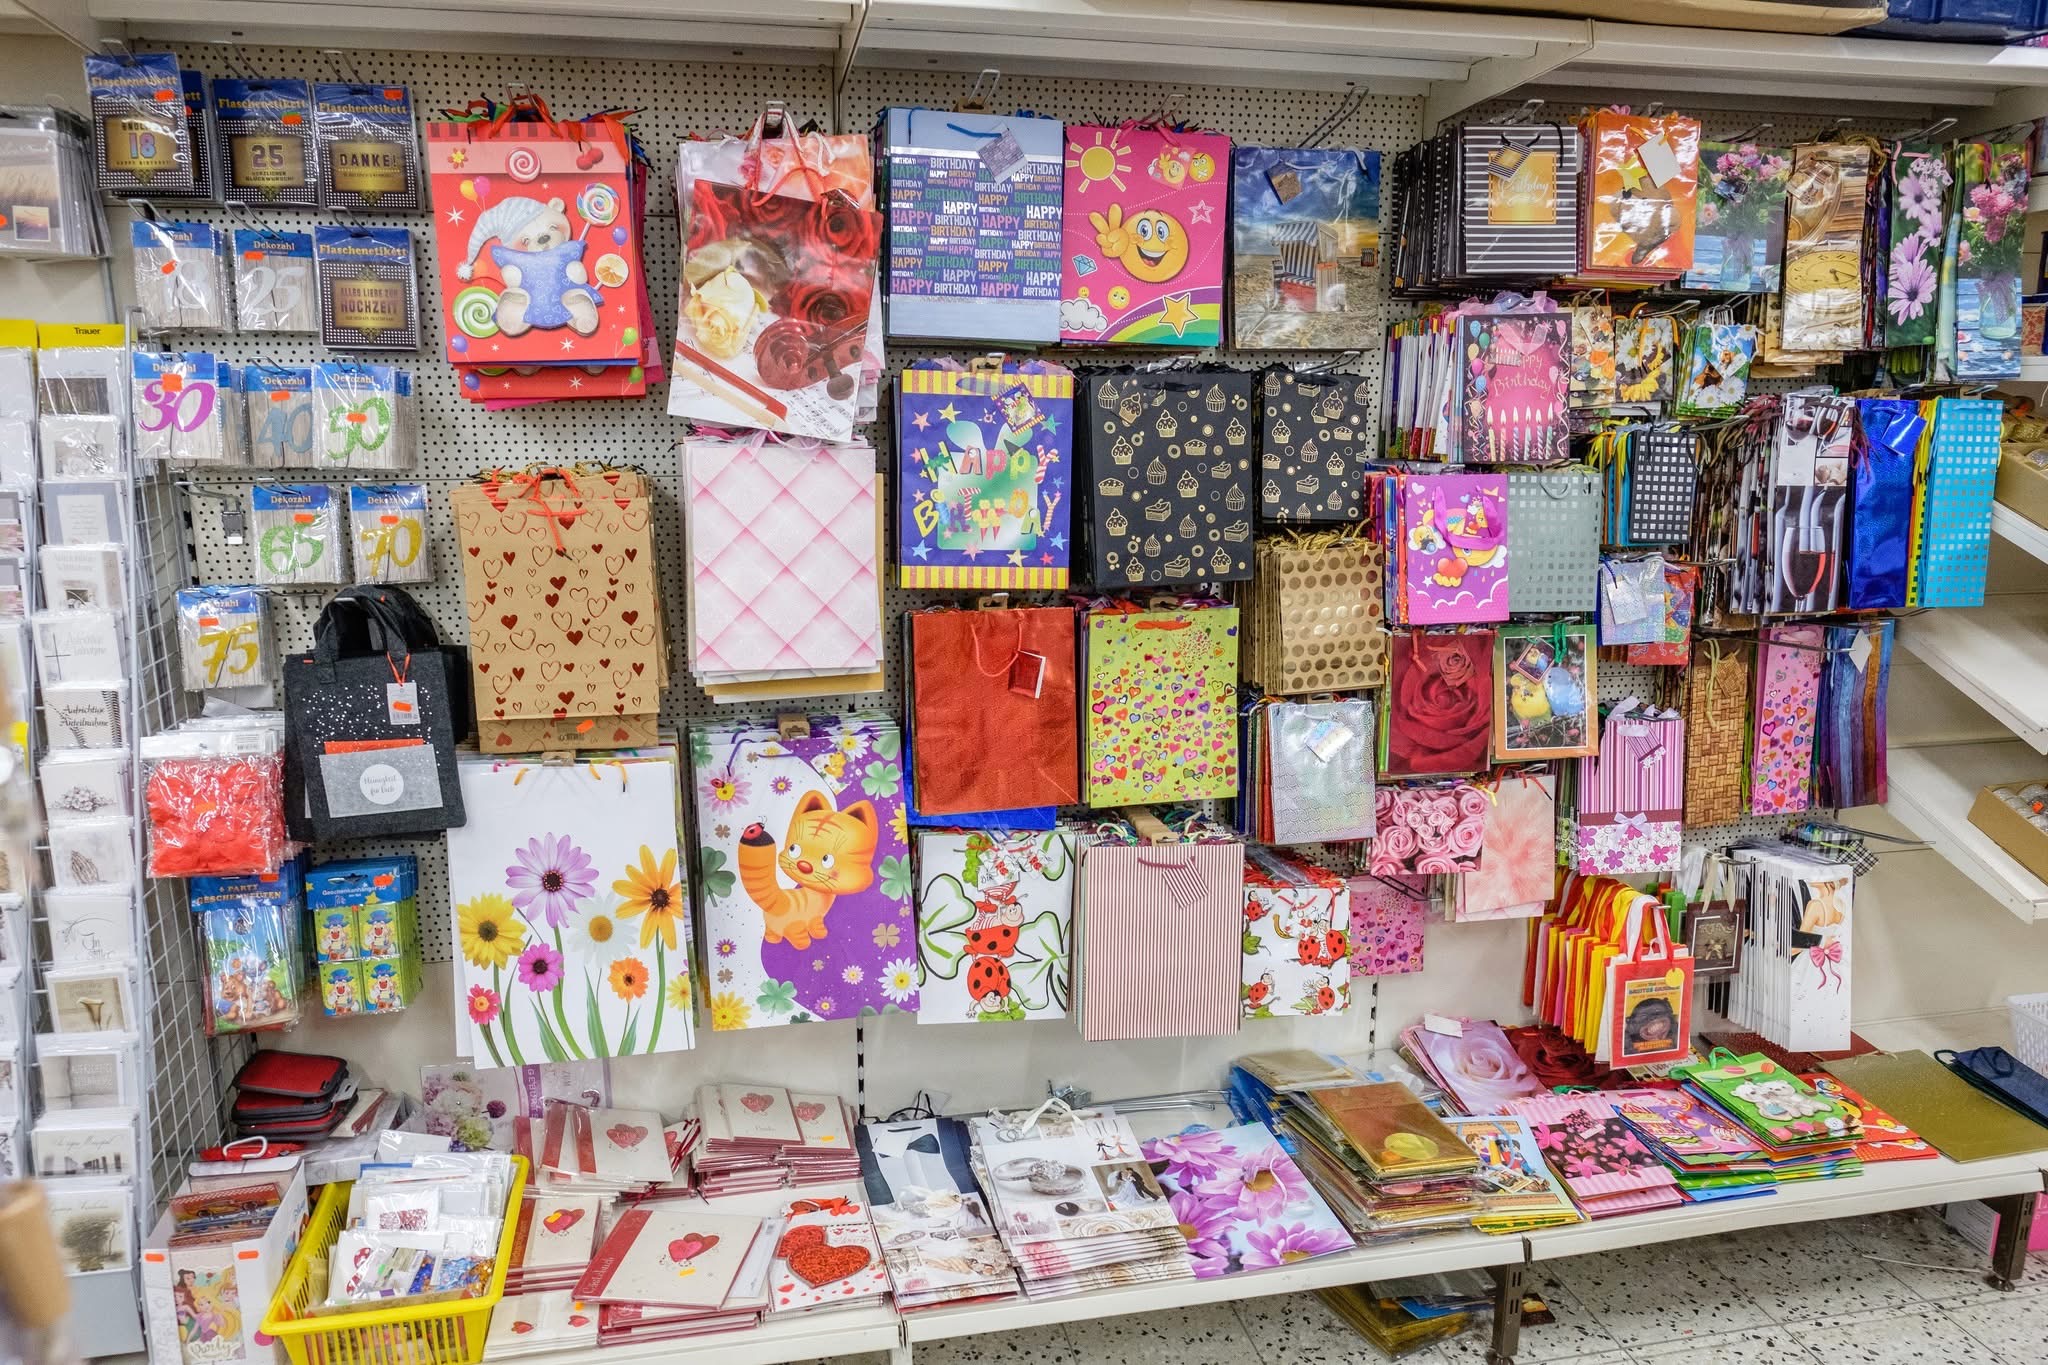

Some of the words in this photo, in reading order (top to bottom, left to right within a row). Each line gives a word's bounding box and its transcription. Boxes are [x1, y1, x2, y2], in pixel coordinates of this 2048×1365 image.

[218, 99, 307, 111] Flaschenetikett
[319, 102, 408, 115] Flaschenetikett
[129, 133, 156, 159] 18
[251, 144, 284, 169] 25
[340, 154, 397, 168] DANKE!
[931, 157, 976, 171] BIRTHDAY!
[892, 165, 928, 179] HAPPY
[929, 170, 948, 178] HAPPY
[1011, 172, 1034, 182] HAPPY
[892, 188, 923, 201] HAPPY
[978, 193, 1008, 205] HAPPY
[943, 200, 978, 215] HAPPY
[1026, 204, 1063, 220] HAPPY
[892, 209, 933, 226] HAPPY
[982, 214, 1020, 230] HAPPY
[892, 232, 928, 246] HAPPY
[1018, 229, 1061, 242] BIRTHDAY!
[253, 240, 295, 251] Dekozahl
[319, 243, 408, 257] Flaschenetikett
[979, 237, 1009, 249] HAPPY
[1011, 239, 1034, 250] HAPPY
[892, 256, 923, 269] HAPPY
[978, 260, 1008, 273] HAPPY
[943, 268, 977, 283] HAPPY
[1026, 271, 1062, 287] HAPPY
[240, 265, 305, 316] 25
[892, 277, 933, 294] HAPPY
[934, 282, 978, 295] BIRTHDAY!
[981, 282, 1019, 297] HAPPY
[341, 300, 397, 314] HOCHZEIT
[74, 327, 101, 336] Trauer
[264, 376, 306, 386] Dekozahl
[1494, 372, 1551, 400] Birthday
[138, 379, 217, 433] 30
[257, 402, 312, 457] 40
[271, 494, 311, 505] Dekozahl
[259, 513, 324, 576] 65
[361, 517, 423, 577] 70
[199, 620, 260, 685] 75
